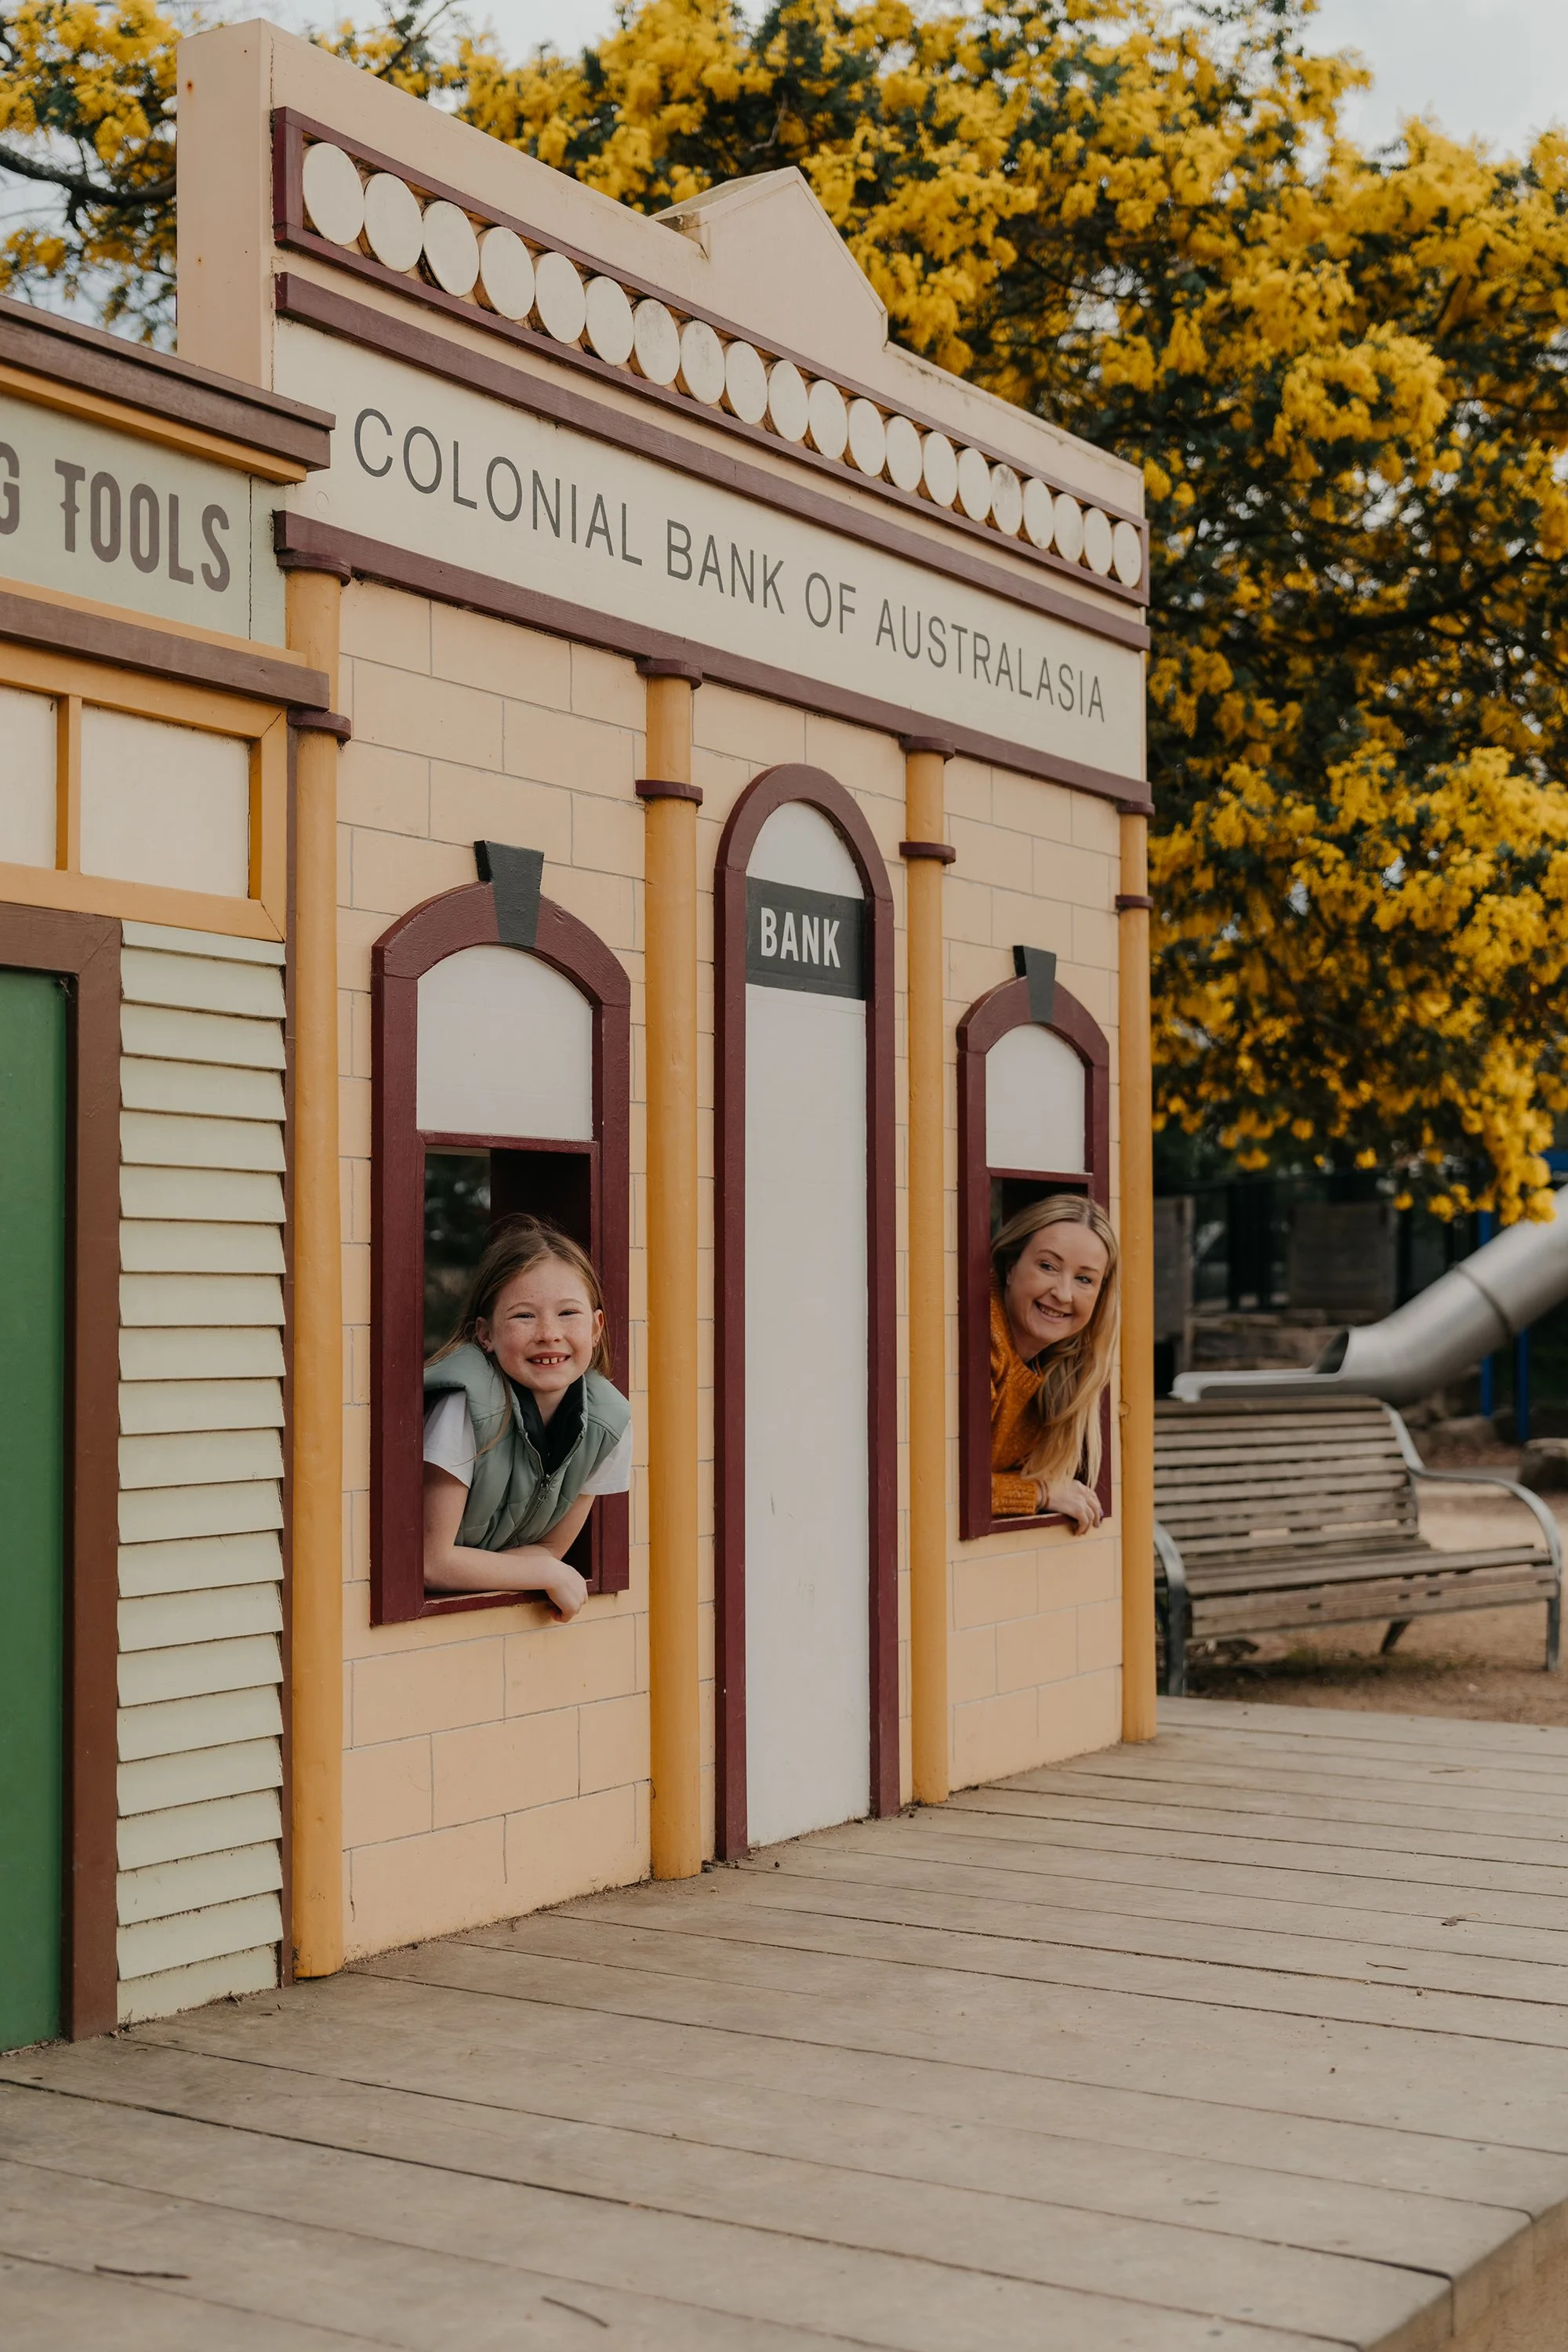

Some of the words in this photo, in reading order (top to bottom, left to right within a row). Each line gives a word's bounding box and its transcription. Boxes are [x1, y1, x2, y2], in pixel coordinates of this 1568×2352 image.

[55, 459, 230, 593] TOOLS
[354, 408, 643, 566] COLONIAL
[666, 519, 785, 614] BANK
[805, 572, 856, 634] OF
[876, 598, 1105, 723] AUSTRALASIA
[760, 906, 841, 968] BANK
